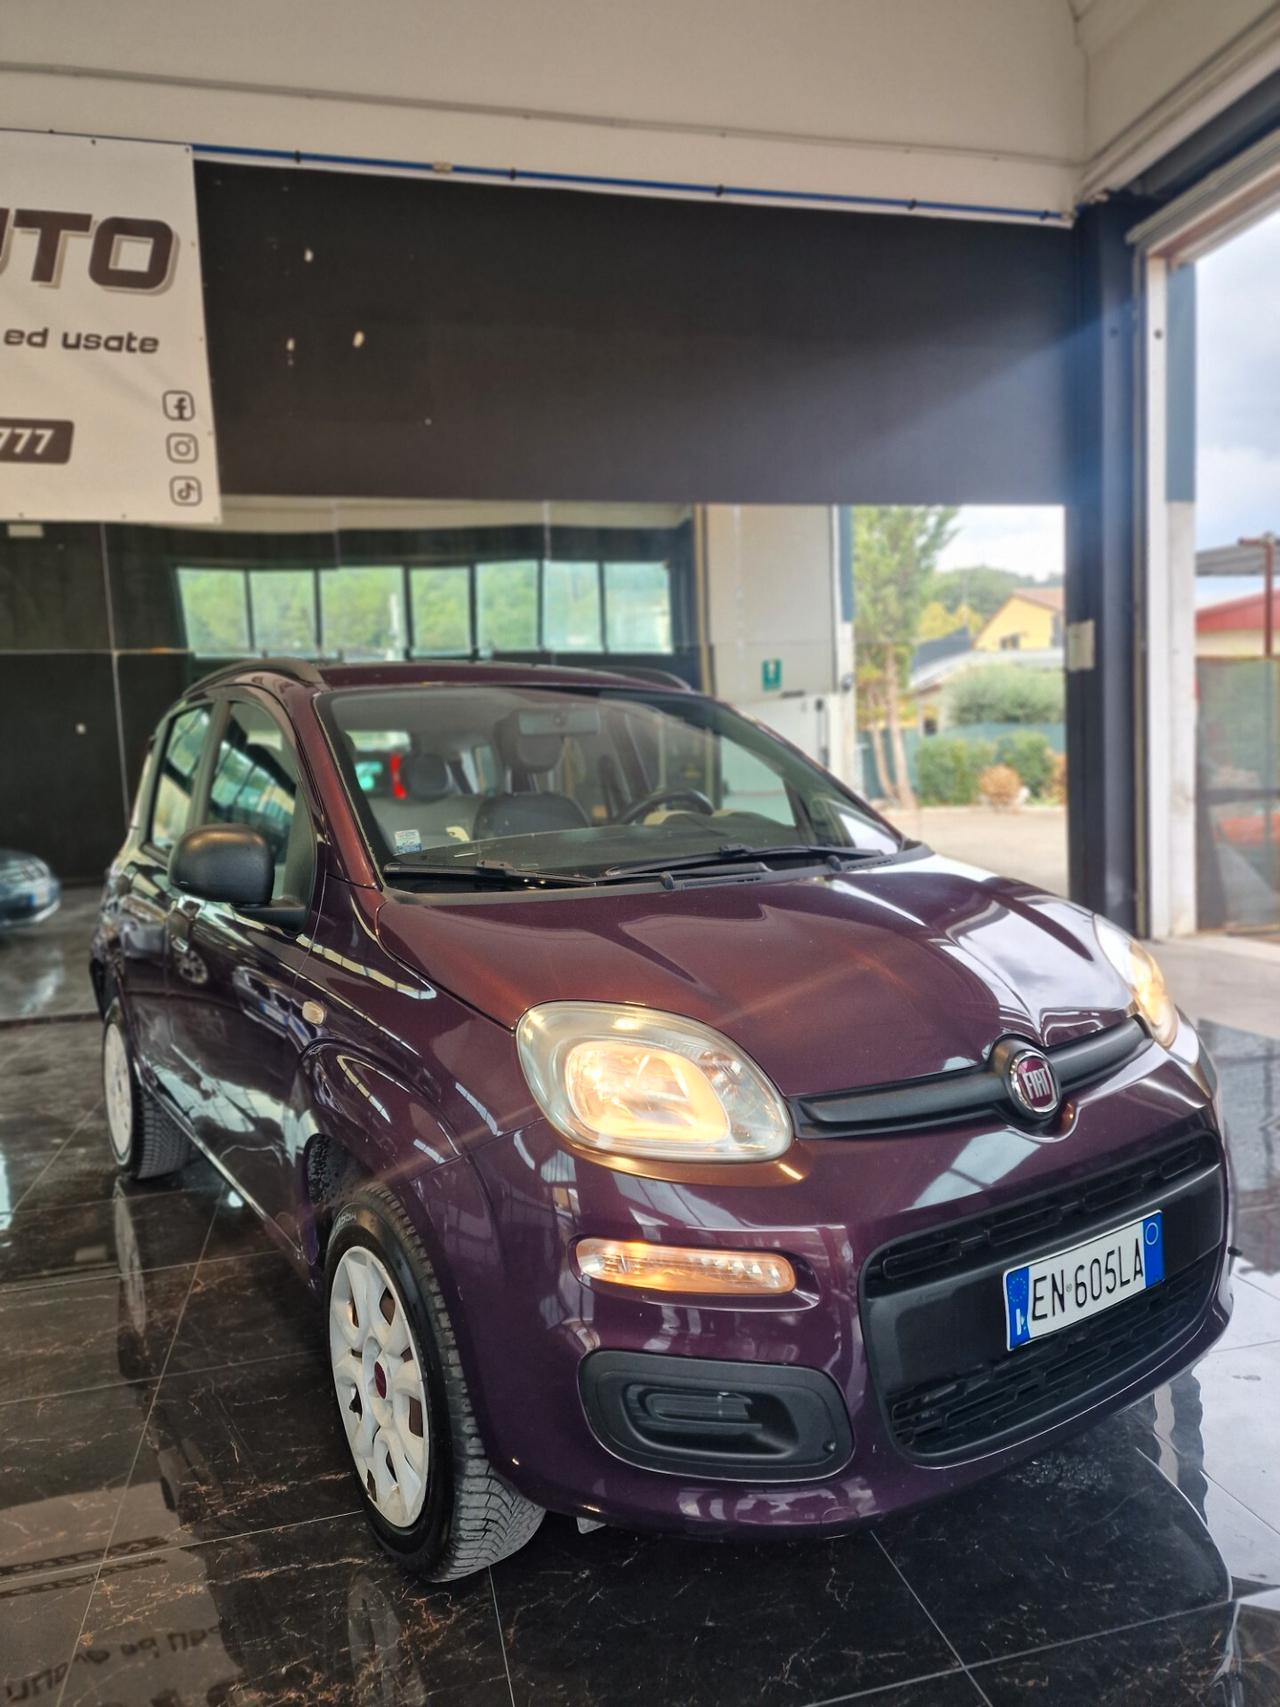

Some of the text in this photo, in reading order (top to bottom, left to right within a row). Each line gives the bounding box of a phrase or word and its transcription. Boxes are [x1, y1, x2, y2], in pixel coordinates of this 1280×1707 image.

[0, 208, 178, 294] TO
[3, 327, 160, 355] ed usate
[1024, 1067, 1049, 1100] FIAT
[1031, 1237, 1144, 1321] EN 605LA
